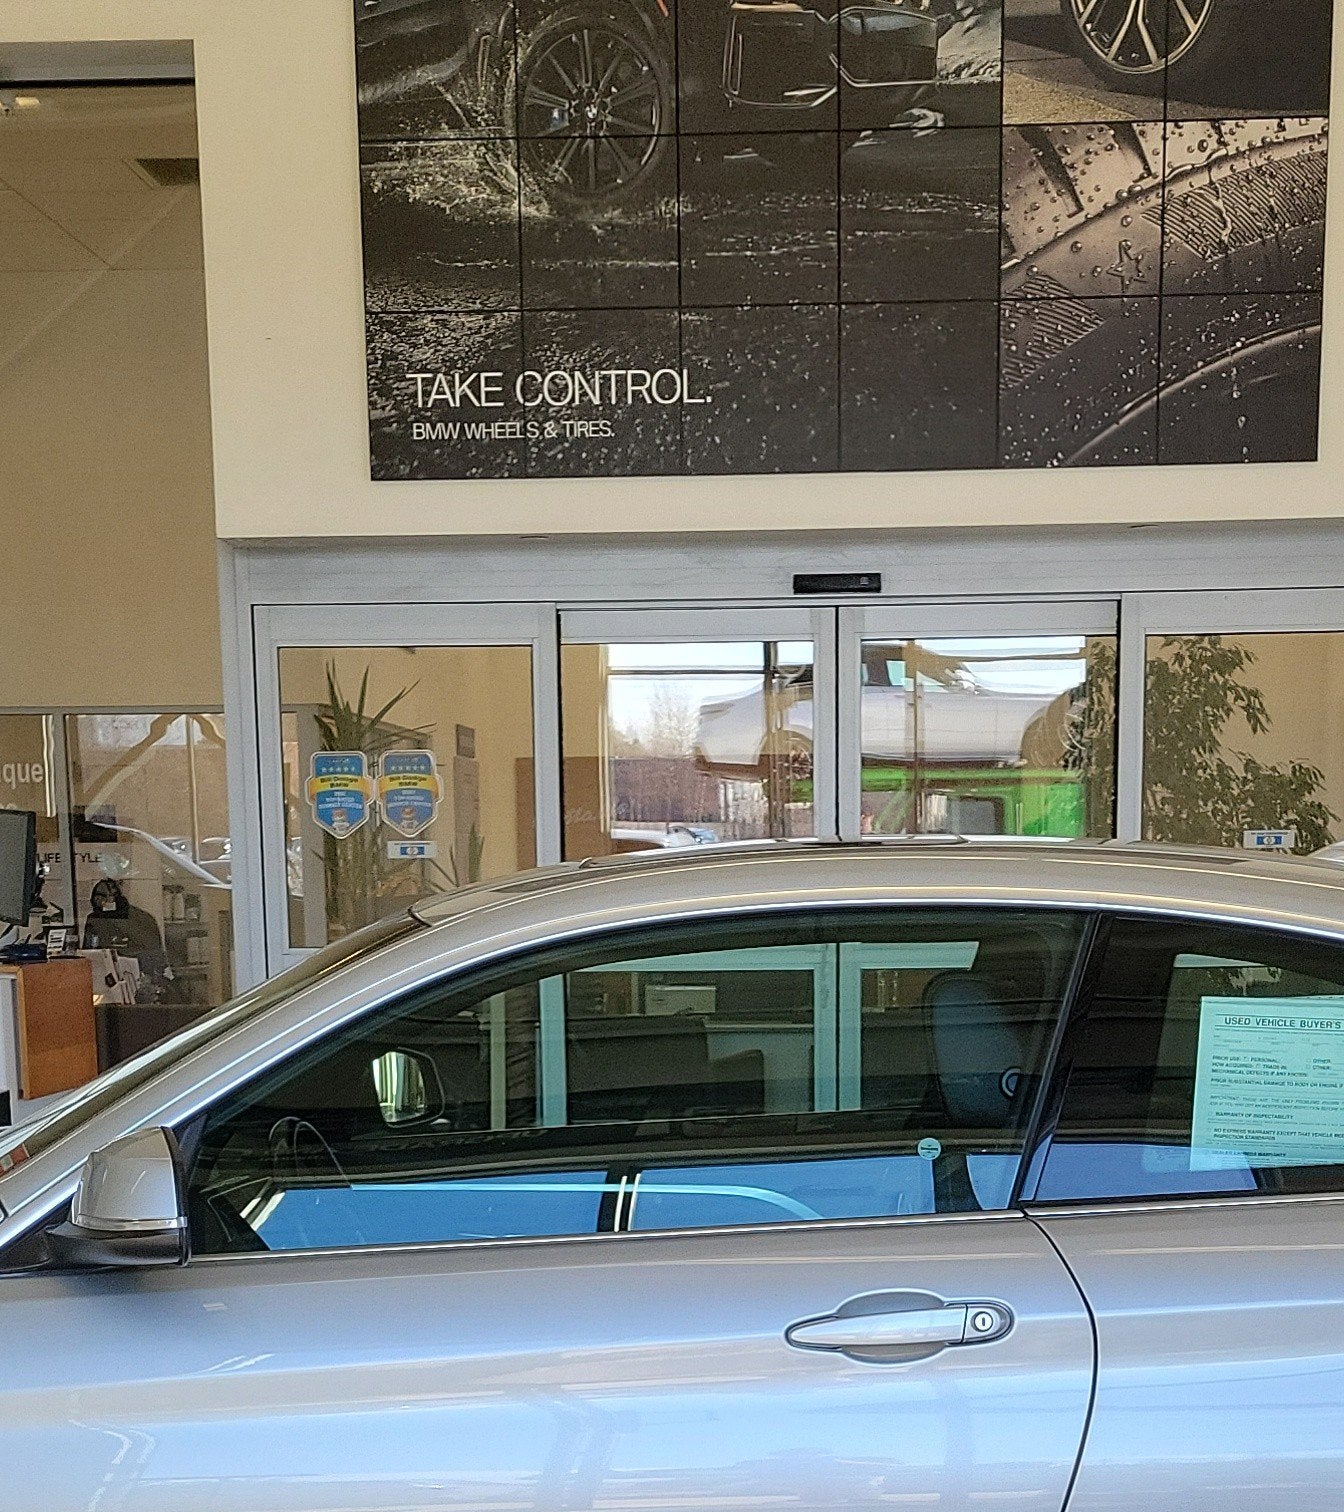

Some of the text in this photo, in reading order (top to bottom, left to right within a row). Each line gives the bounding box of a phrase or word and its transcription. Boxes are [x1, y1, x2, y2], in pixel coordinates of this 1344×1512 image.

[406, 368, 712, 408] TAKE CONTROL.
[413, 420, 615, 441] BMW WHEELS & TIRES.
[1224, 1016, 1251, 1026] USED
[1255, 1018, 1295, 1027] VEHICLE
[1300, 1020, 1341, 1029] BUYER'S
